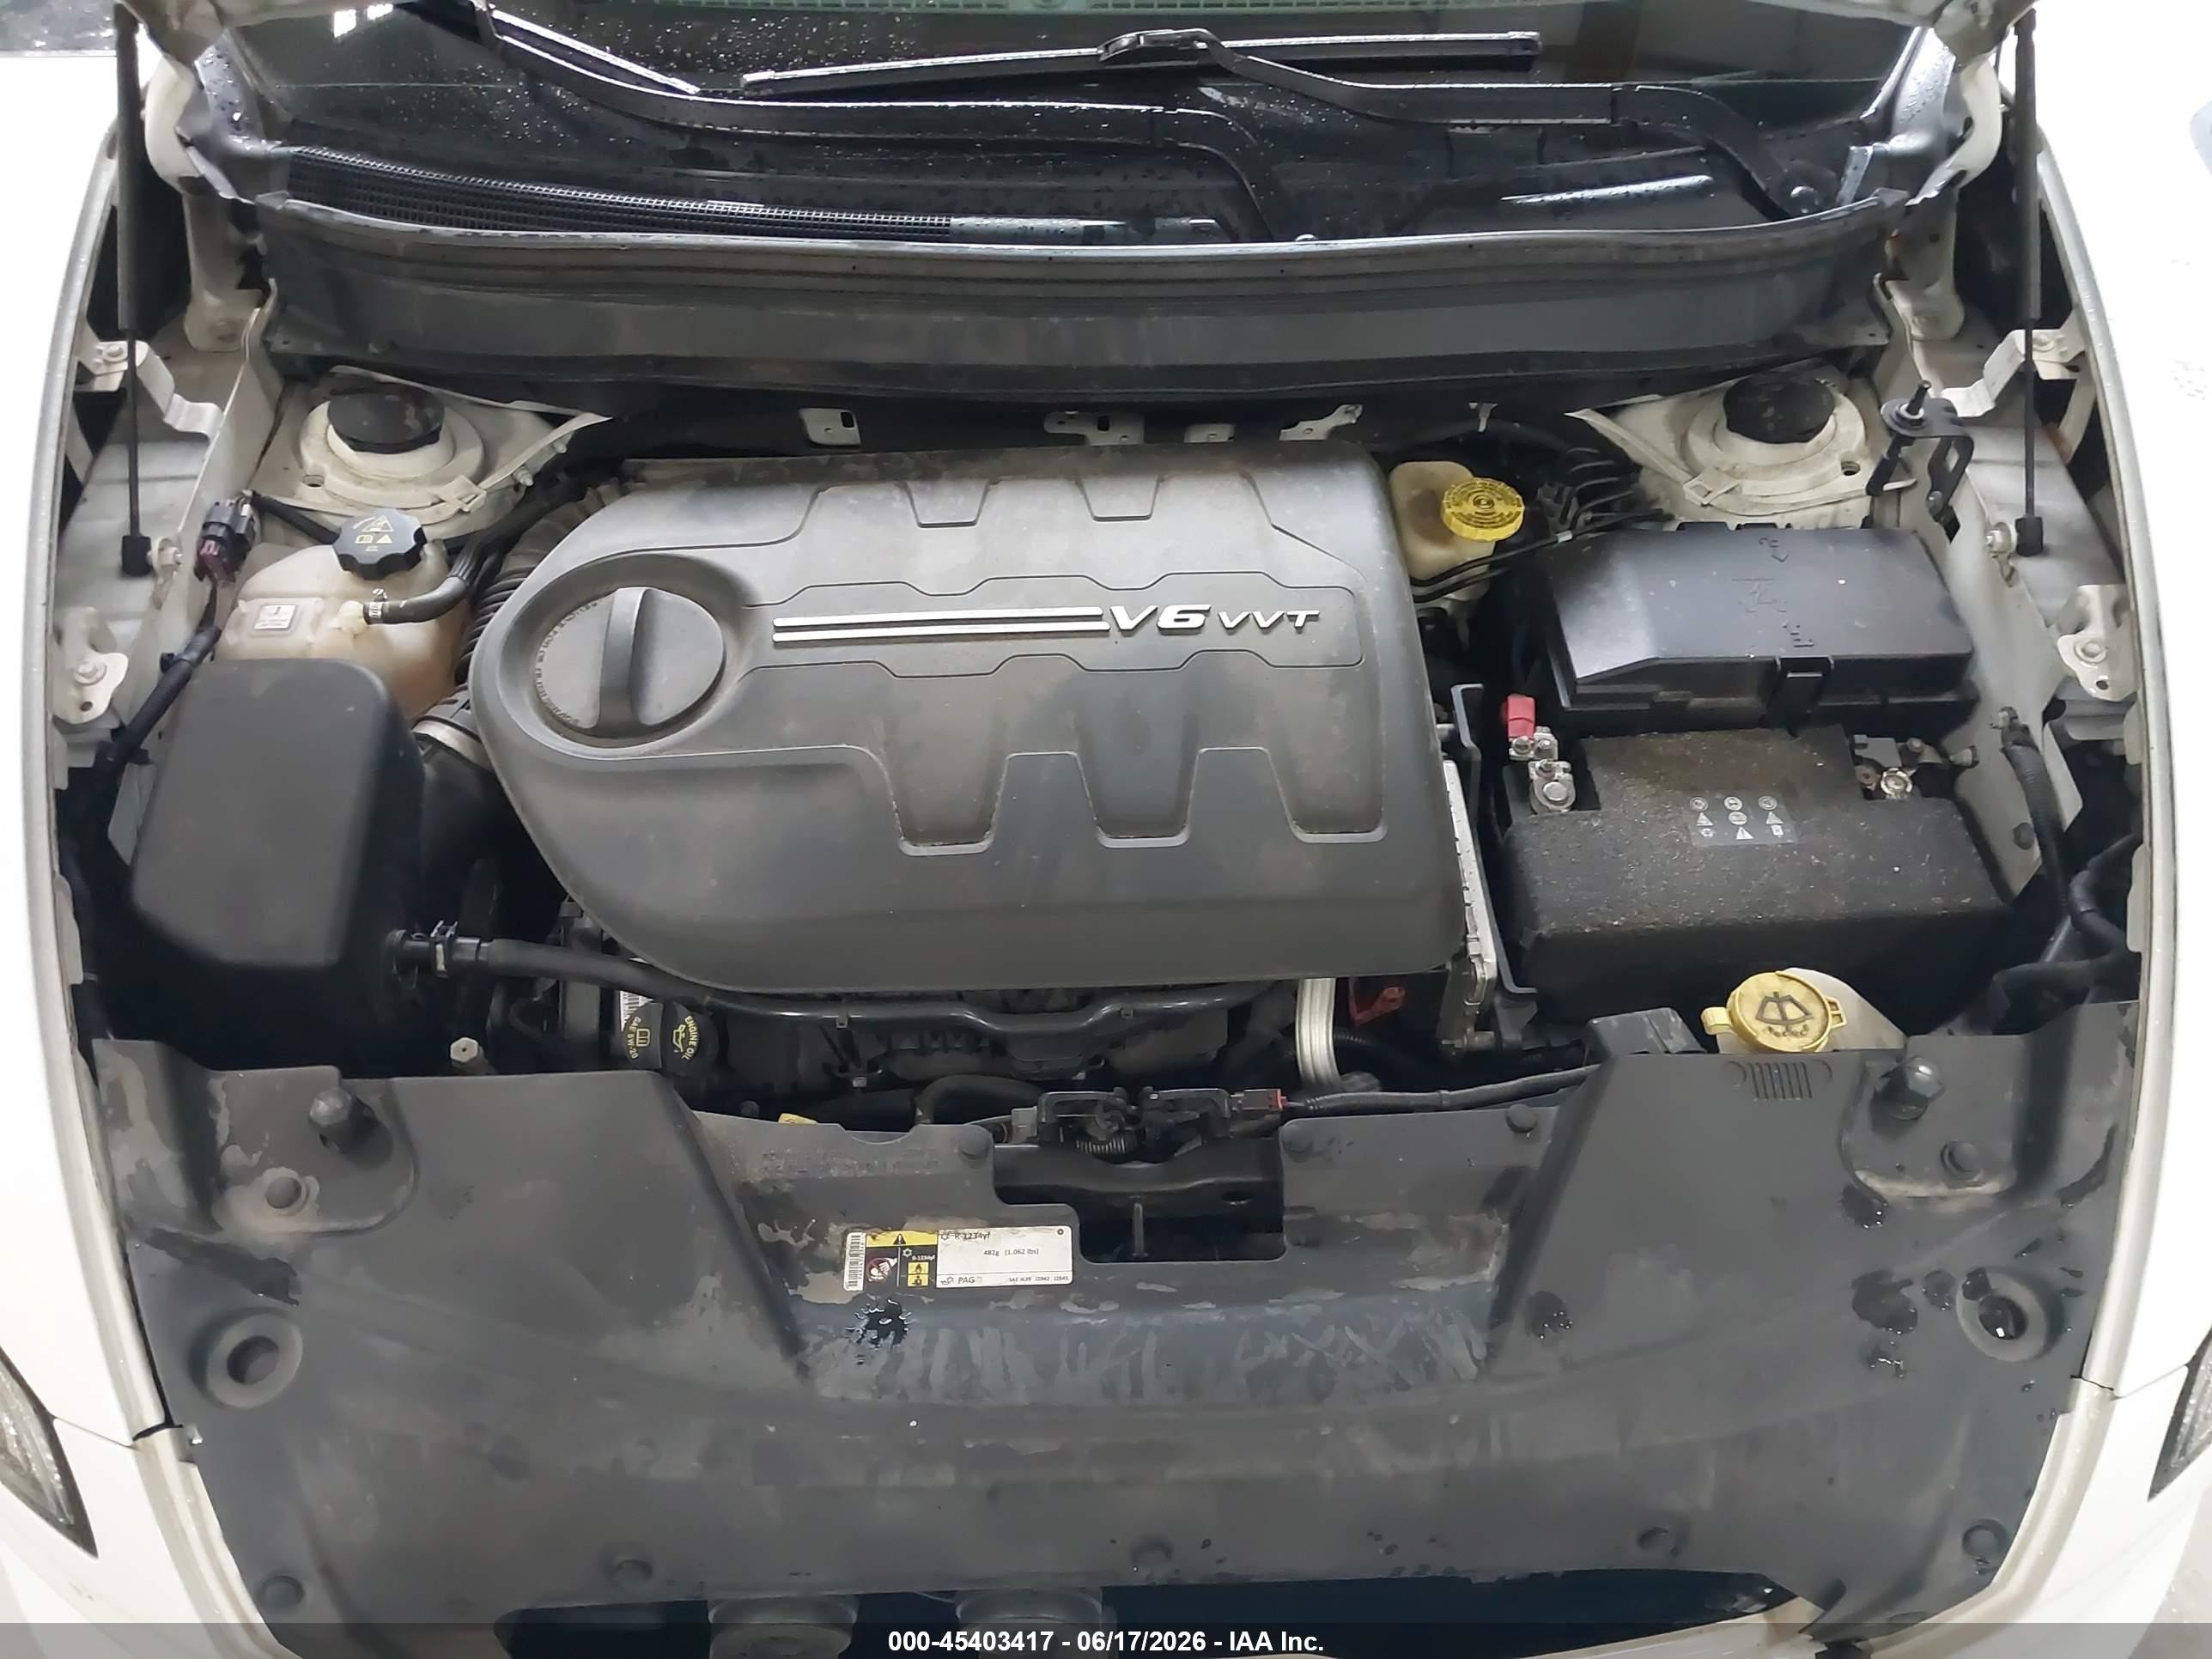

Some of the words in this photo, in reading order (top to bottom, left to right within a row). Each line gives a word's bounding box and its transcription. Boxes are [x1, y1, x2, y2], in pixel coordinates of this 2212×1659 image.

[1109, 604, 1212, 631] V6
[1218, 609, 1321, 630] VVT
[684, 1015, 699, 1046] ENGINE
[681, 1047, 696, 1061] OIL
